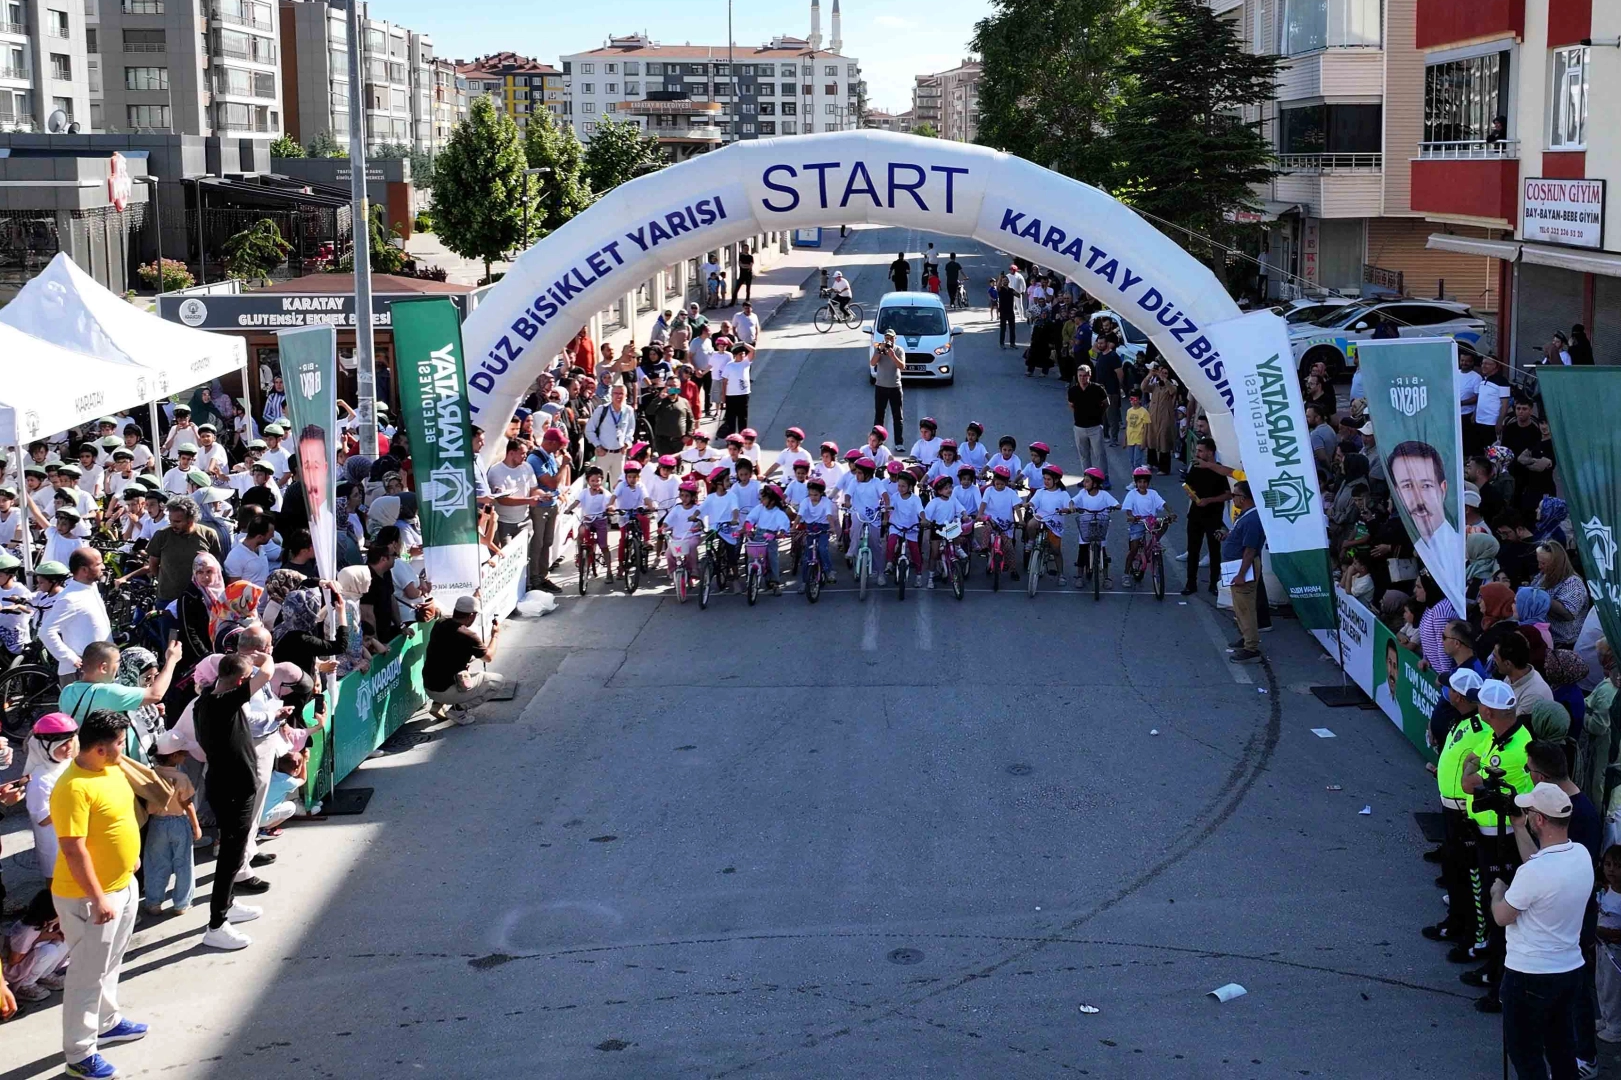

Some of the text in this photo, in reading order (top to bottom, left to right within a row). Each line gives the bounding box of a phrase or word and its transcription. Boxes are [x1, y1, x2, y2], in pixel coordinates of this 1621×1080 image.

[761, 161, 970, 213] START
[1526, 181, 1601, 206] COŞKUN GİYİM
[1525, 207, 1600, 224] BAY-BAYAN-BEBE GİYİM
[999, 208, 1143, 293] KARATAY
[1137, 286, 1199, 343] DÜZ
[282, 297, 345, 311] KARATAY
[468, 196, 728, 395] DÜZ BİSİKLET YARIŞI
[238, 311, 391, 326] GLUTENSİZ EKMEK BESİ
[74, 391, 105, 414] KARATAY
[371, 656, 402, 697] KARATAY
[1404, 661, 1419, 689] TÜM
